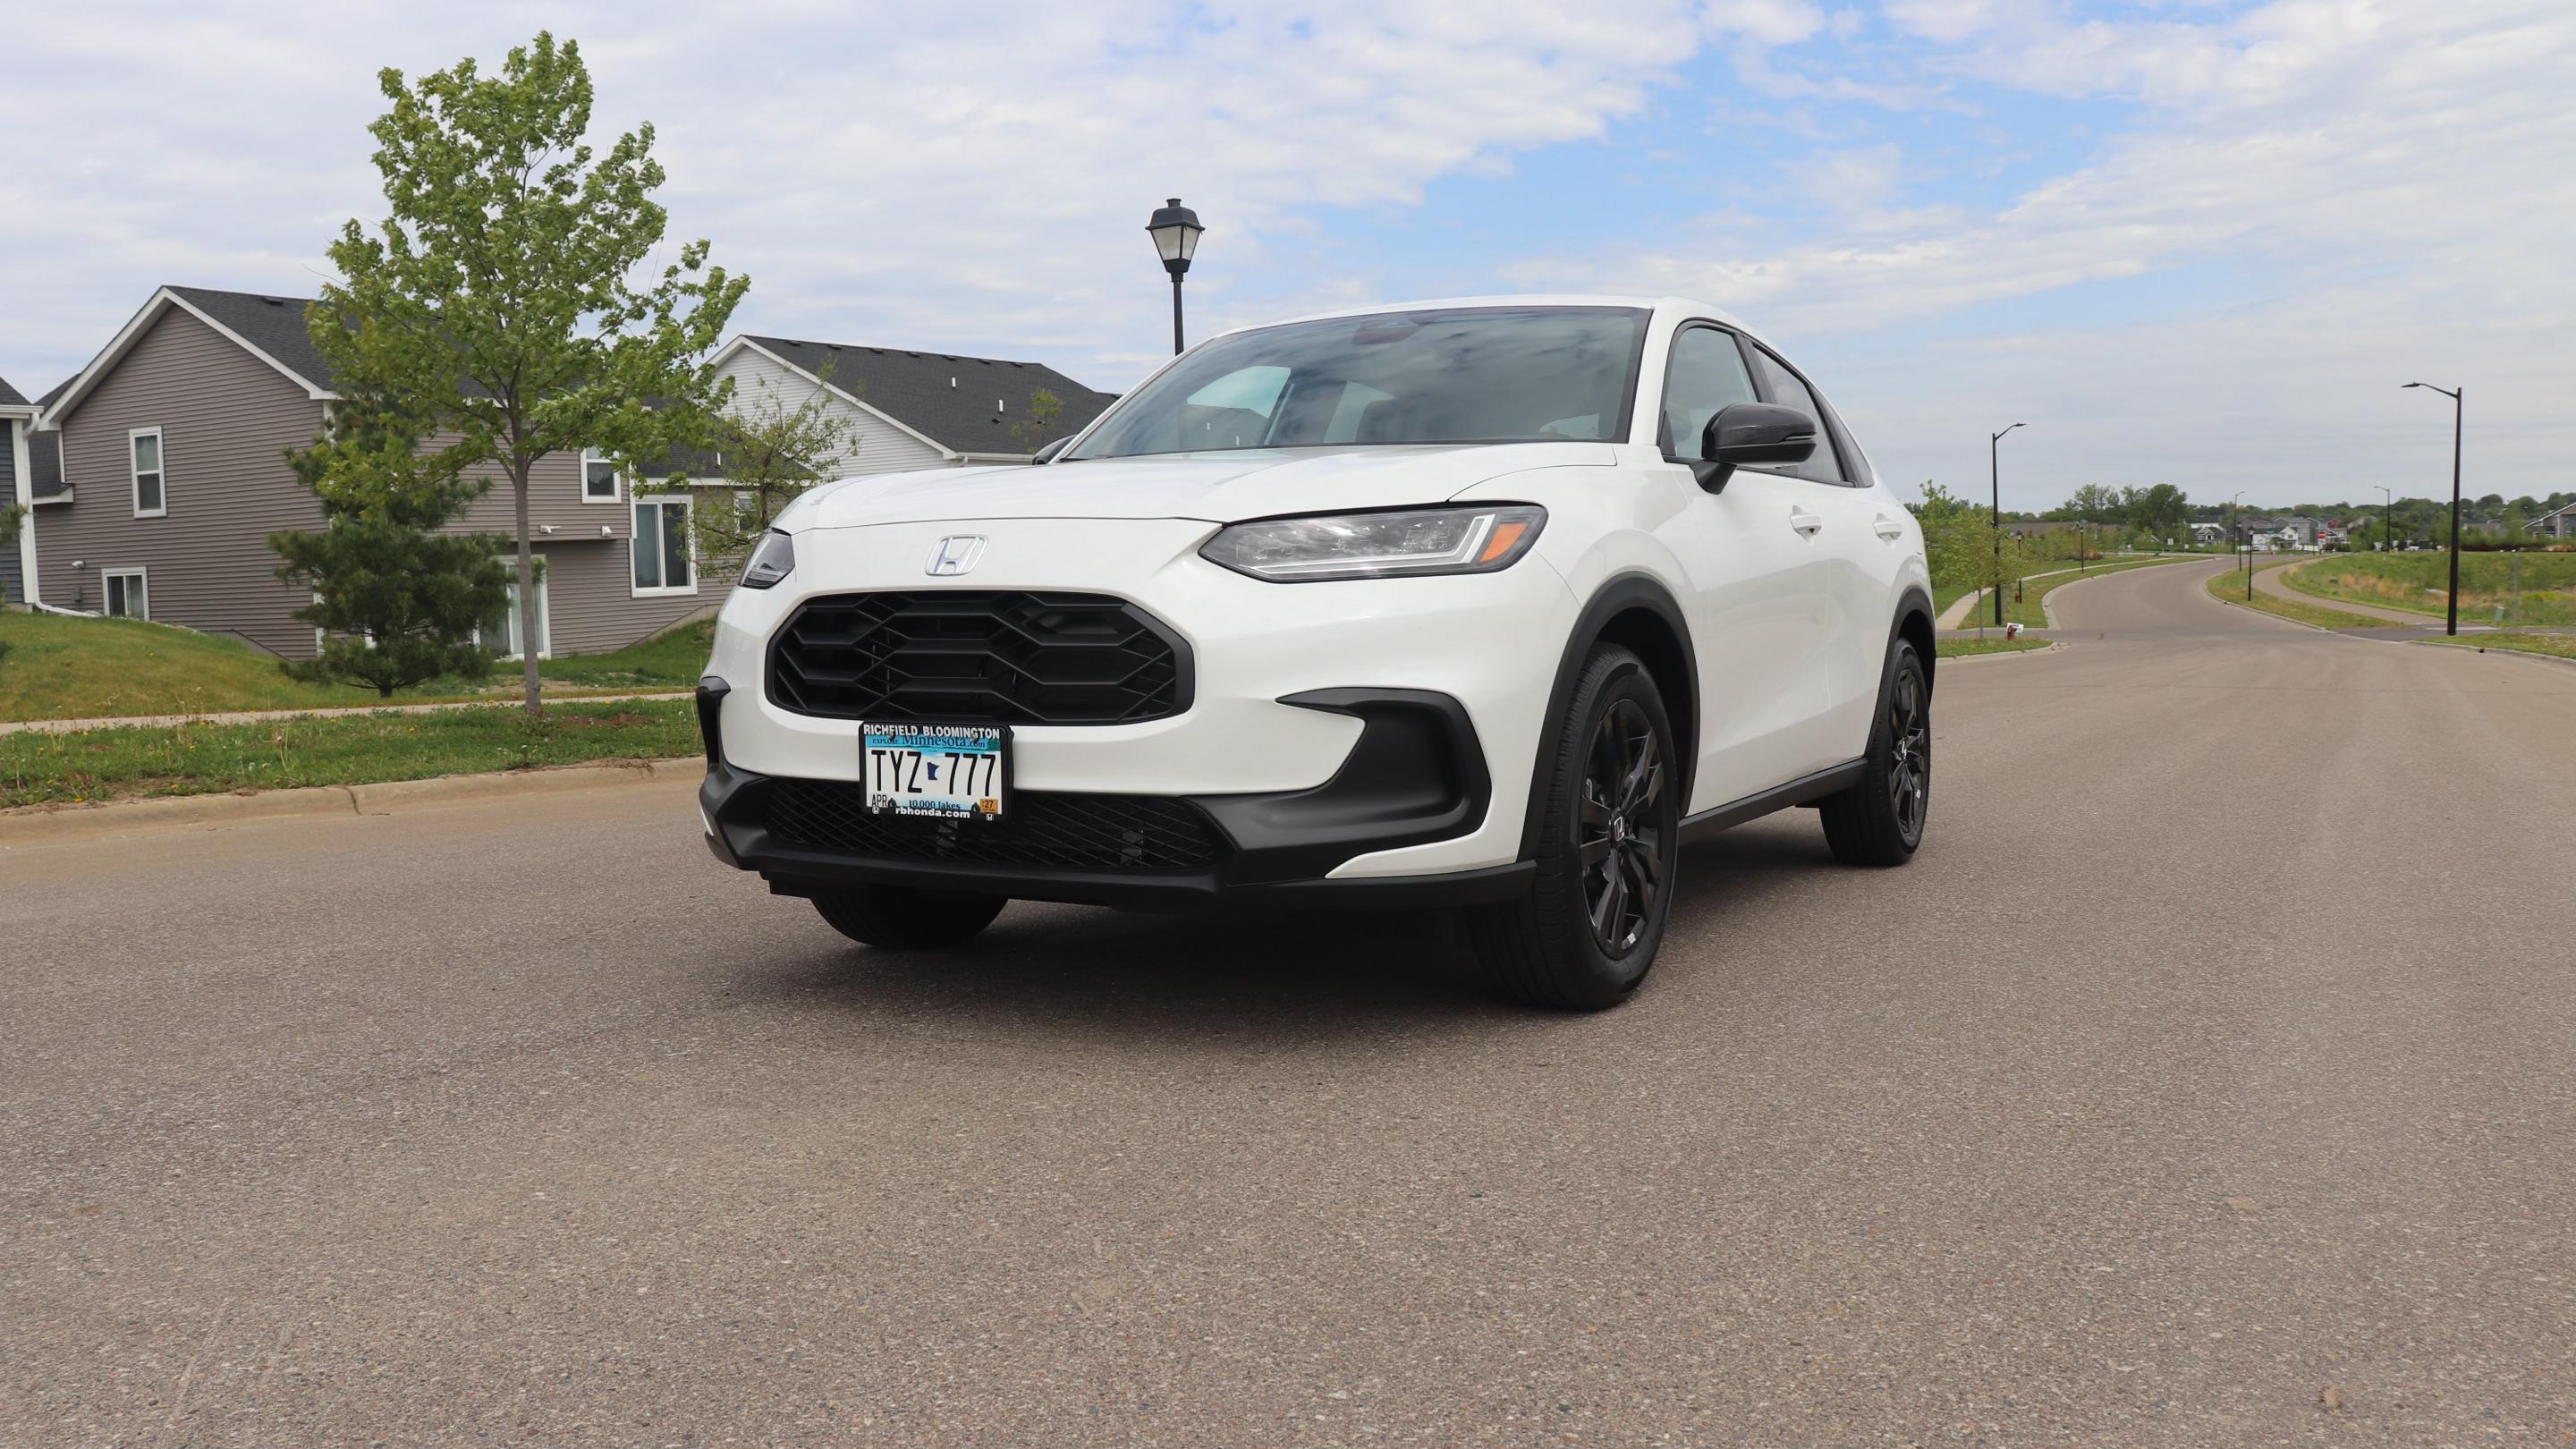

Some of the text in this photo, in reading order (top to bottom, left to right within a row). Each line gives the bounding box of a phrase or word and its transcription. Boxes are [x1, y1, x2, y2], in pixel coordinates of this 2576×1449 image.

[863, 724, 1000, 740] RICHFIELD BLOOMINGTON
[871, 750, 996, 797] TYZ 777
[872, 793, 887, 808] APR
[985, 800, 995, 809] 27
[937, 801, 961, 809] lakes
[895, 806, 971, 818] rbhonda.com
